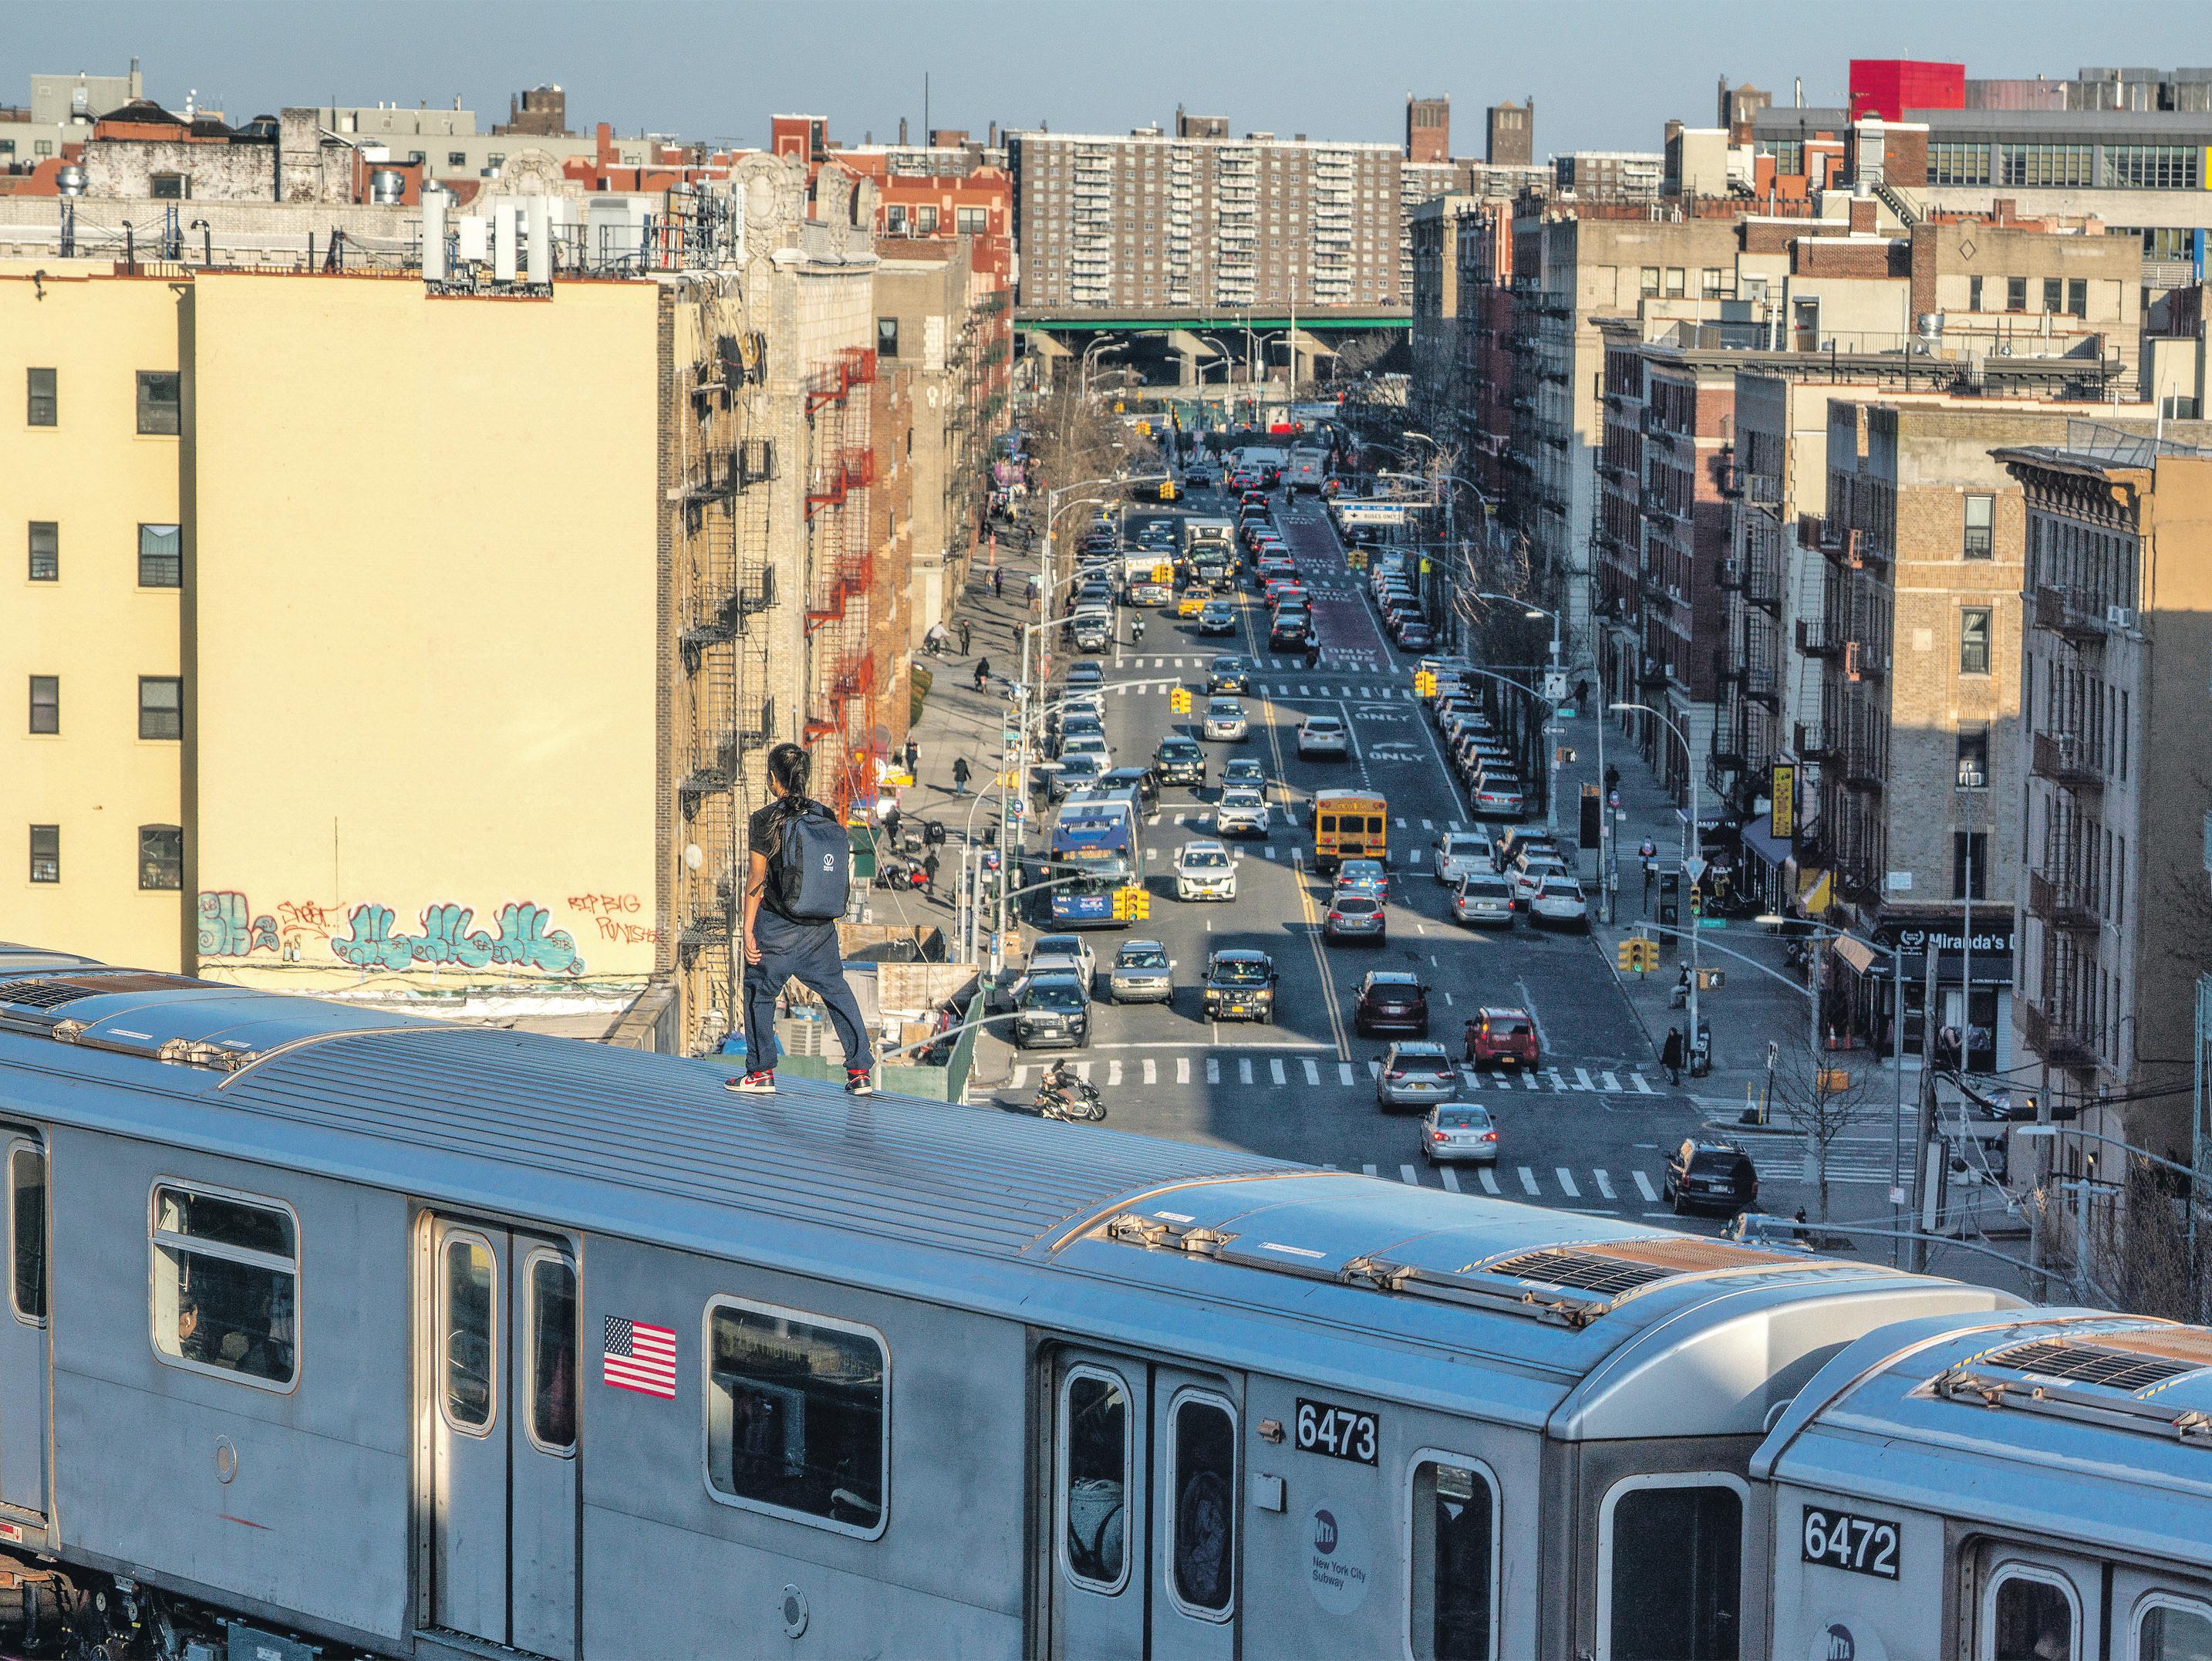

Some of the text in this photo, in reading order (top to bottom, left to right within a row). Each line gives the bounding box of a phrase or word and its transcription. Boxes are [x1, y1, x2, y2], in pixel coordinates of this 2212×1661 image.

[1355, 713, 1410, 722] ONLY
[1369, 752, 1425, 761] ONLY
[600, 894, 641, 914] BIG
[1298, 1404, 1376, 1460] 6473
[1806, 1511, 1897, 1575] 6472
[1313, 1555, 1366, 1584] New York City
[1313, 1569, 1345, 1591] Subway
